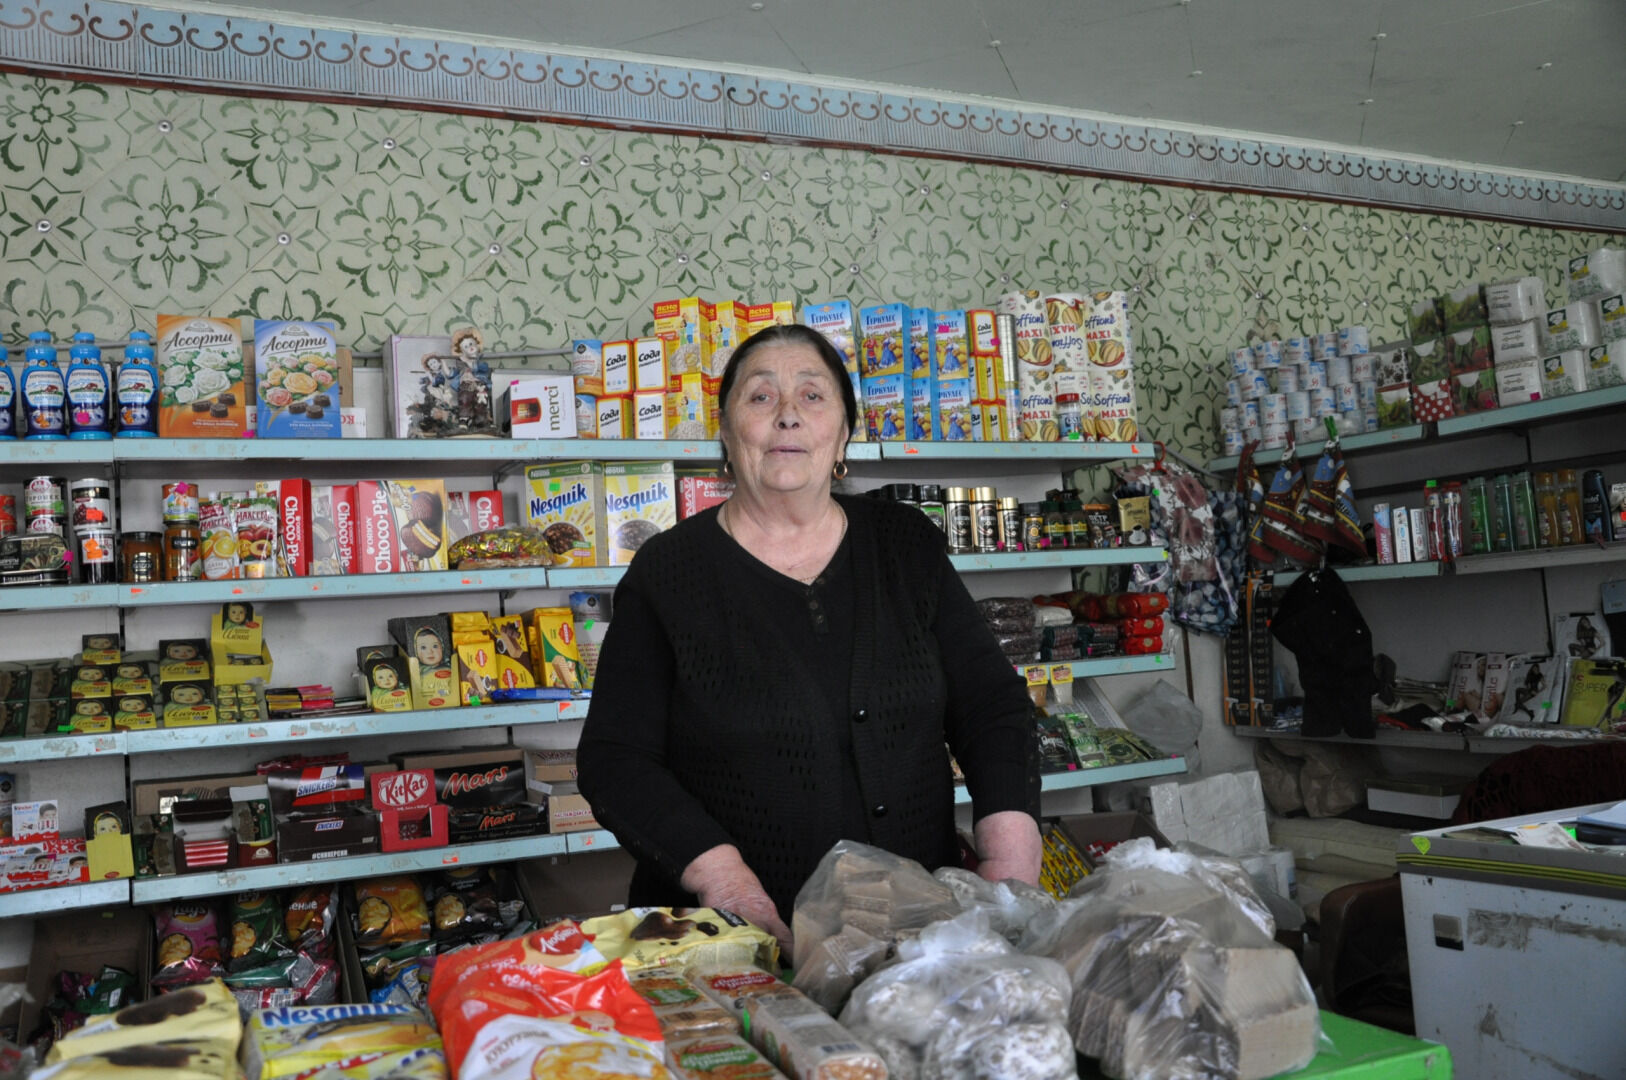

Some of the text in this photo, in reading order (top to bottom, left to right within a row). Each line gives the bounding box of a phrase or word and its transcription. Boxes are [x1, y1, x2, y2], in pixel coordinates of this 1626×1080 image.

[164, 331, 233, 352] Ассорти
[261, 336, 328, 357] Ассорти
[606, 352, 627, 367] Сода
[638, 349, 661, 363] Сода
[545, 384, 561, 432] merci
[600, 408, 619, 423] Сода
[639, 404, 662, 417] Сода
[530, 483, 588, 518] Nesquik
[605, 482, 669, 514] Nesquik
[1574, 682, 1607, 694] SUPER
[297, 777, 337, 797] SNICKERS
[383, 773, 426, 805] KitKat
[442, 765, 510, 799] Mars
[315, 820, 344, 831] SNICKERS
[480, 812, 516, 830] Mars
